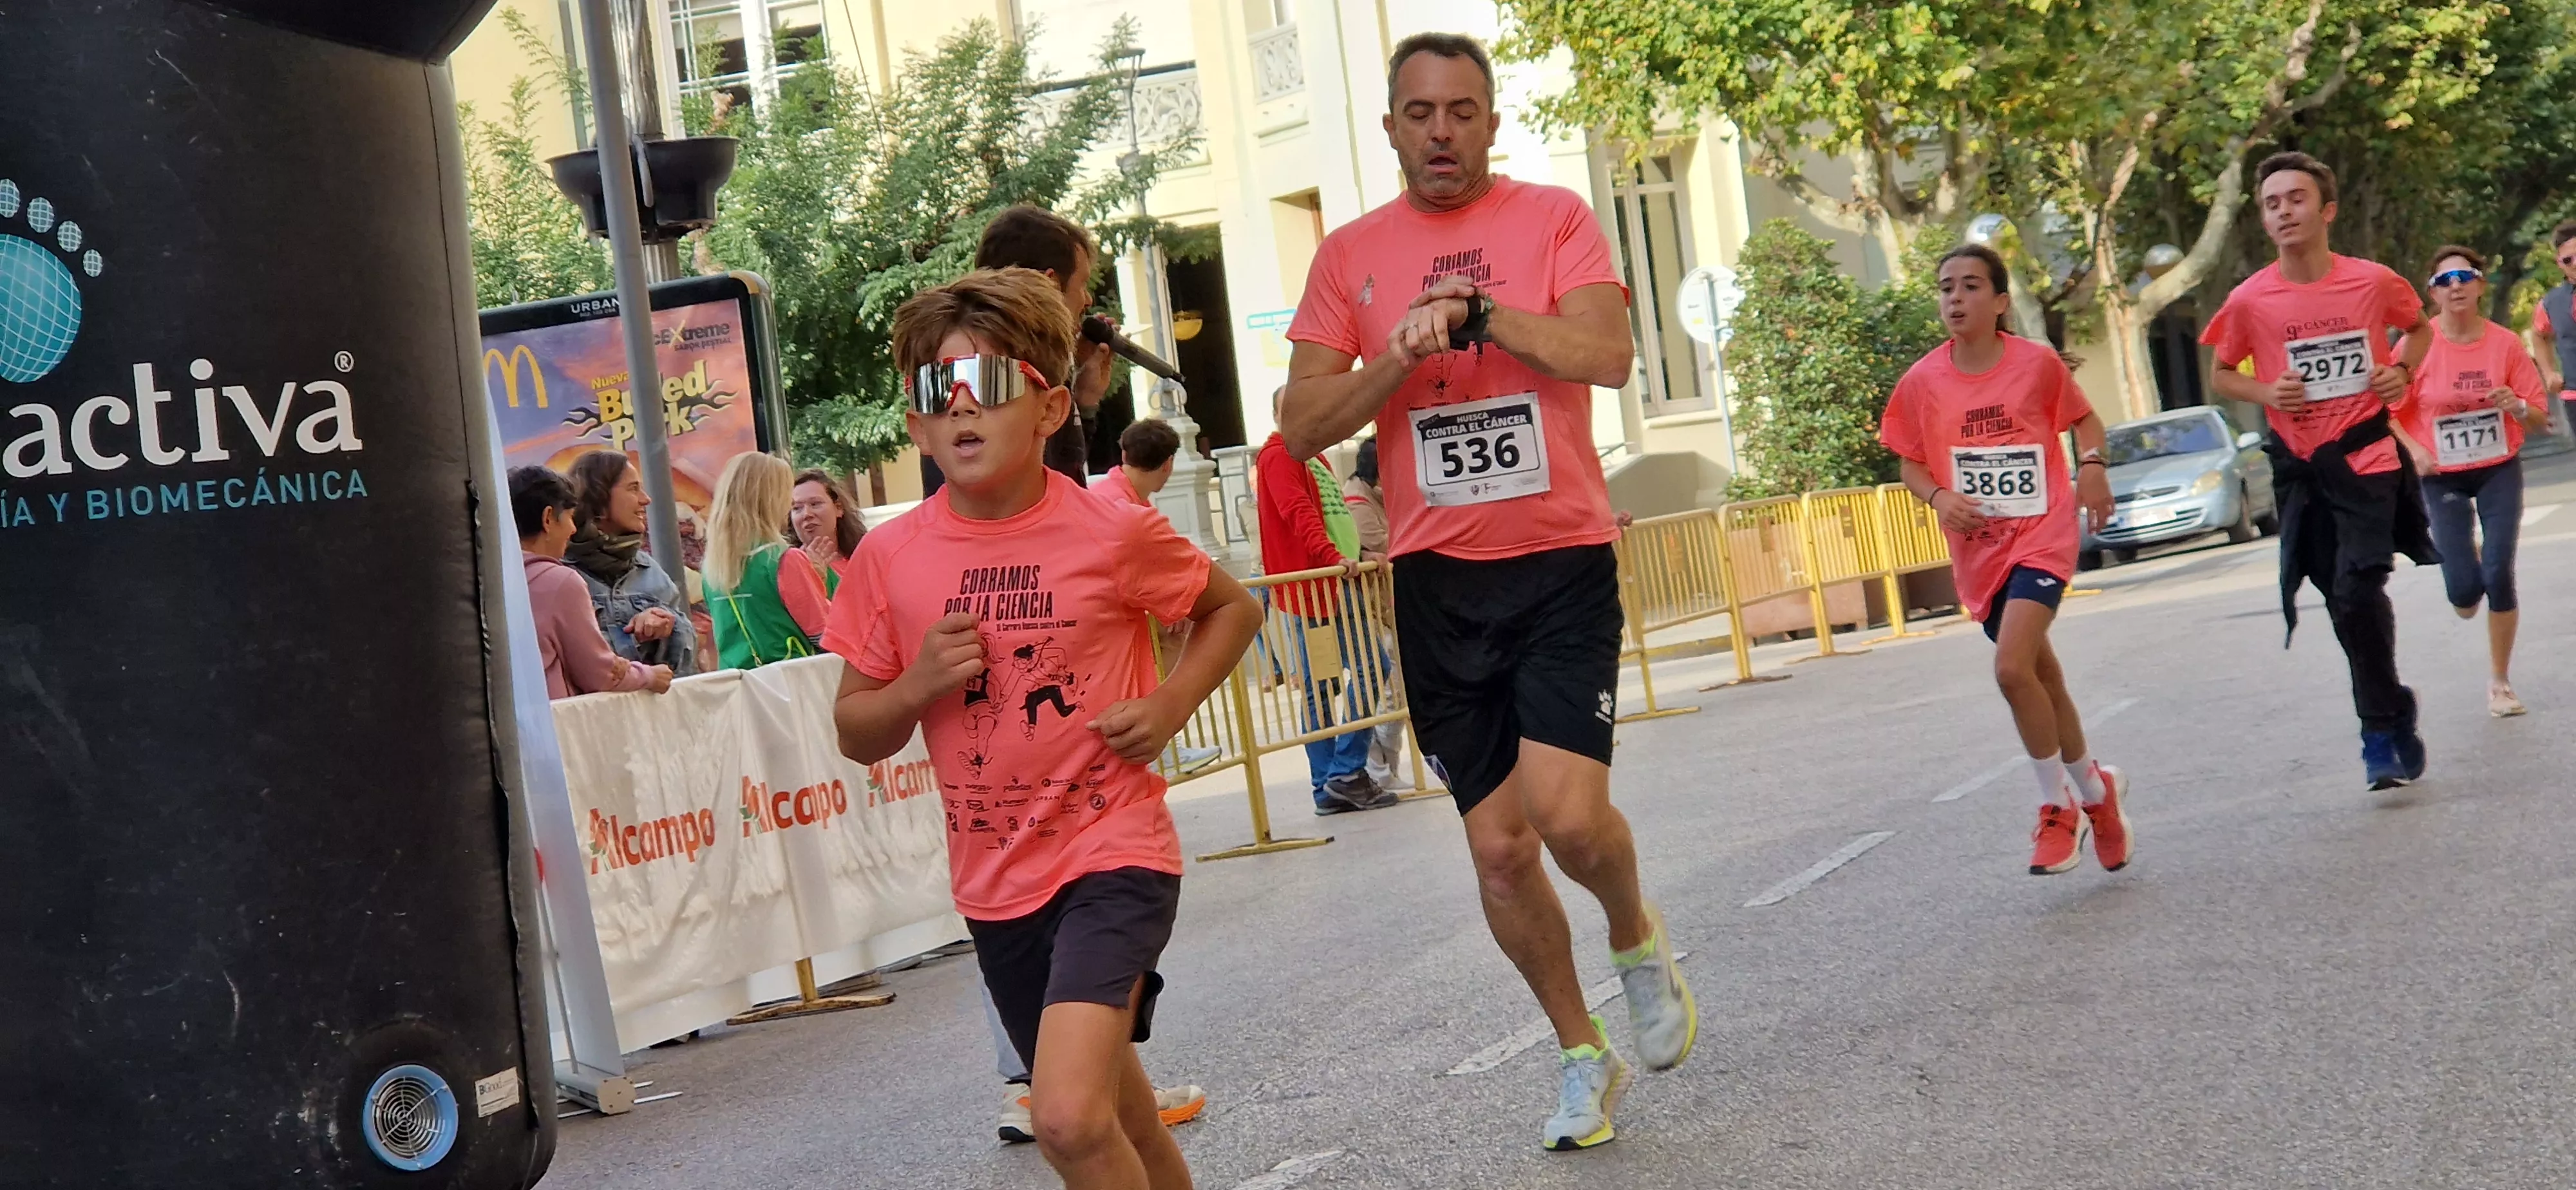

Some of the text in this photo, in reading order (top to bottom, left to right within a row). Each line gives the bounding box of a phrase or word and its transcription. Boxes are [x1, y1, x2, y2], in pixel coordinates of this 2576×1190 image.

[2298, 353, 2366, 382] 2972
[3, 359, 363, 478] activa
[1426, 414, 1528, 439] CONTRA EL CÁNCER
[1457, 412, 1490, 423] HUESCA
[2443, 426, 2497, 449] 1171
[1441, 432, 1520, 478] 536
[47, 492, 69, 522] Y
[86, 467, 367, 521] BIOMECÁNICA
[1962, 469, 2034, 496] 3868
[960, 565, 1041, 595] CORRAMOS
[996, 591, 1053, 621] CIENCIA
[589, 808, 715, 876] Alcampo
